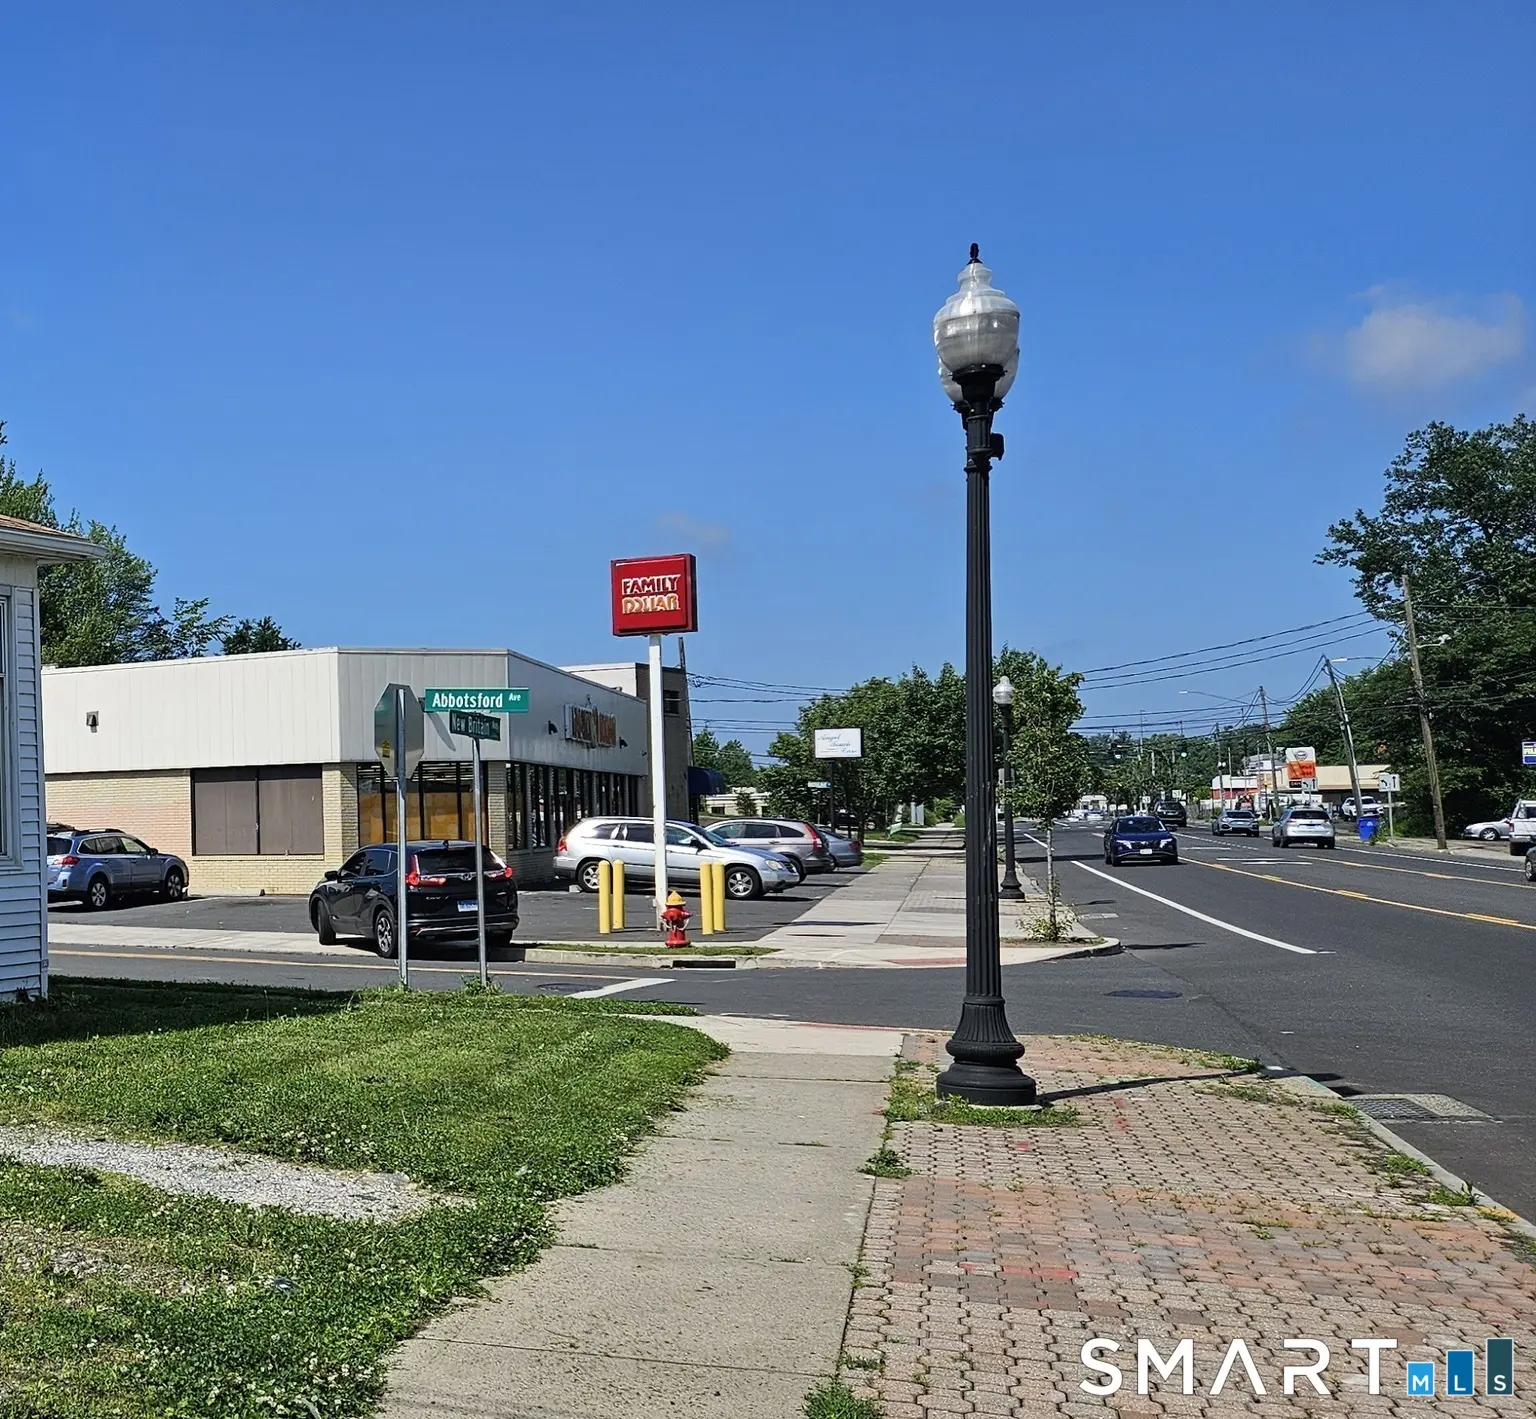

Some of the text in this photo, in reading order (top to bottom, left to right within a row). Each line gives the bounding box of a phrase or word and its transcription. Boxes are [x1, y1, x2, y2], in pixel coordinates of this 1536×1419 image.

[621, 574, 681, 595] FAMILY
[621, 593, 681, 614] DOLLAR
[431, 692, 522, 708] Abbotsford Ave
[451, 713, 466, 732] New
[468, 716, 490, 736] Britain
